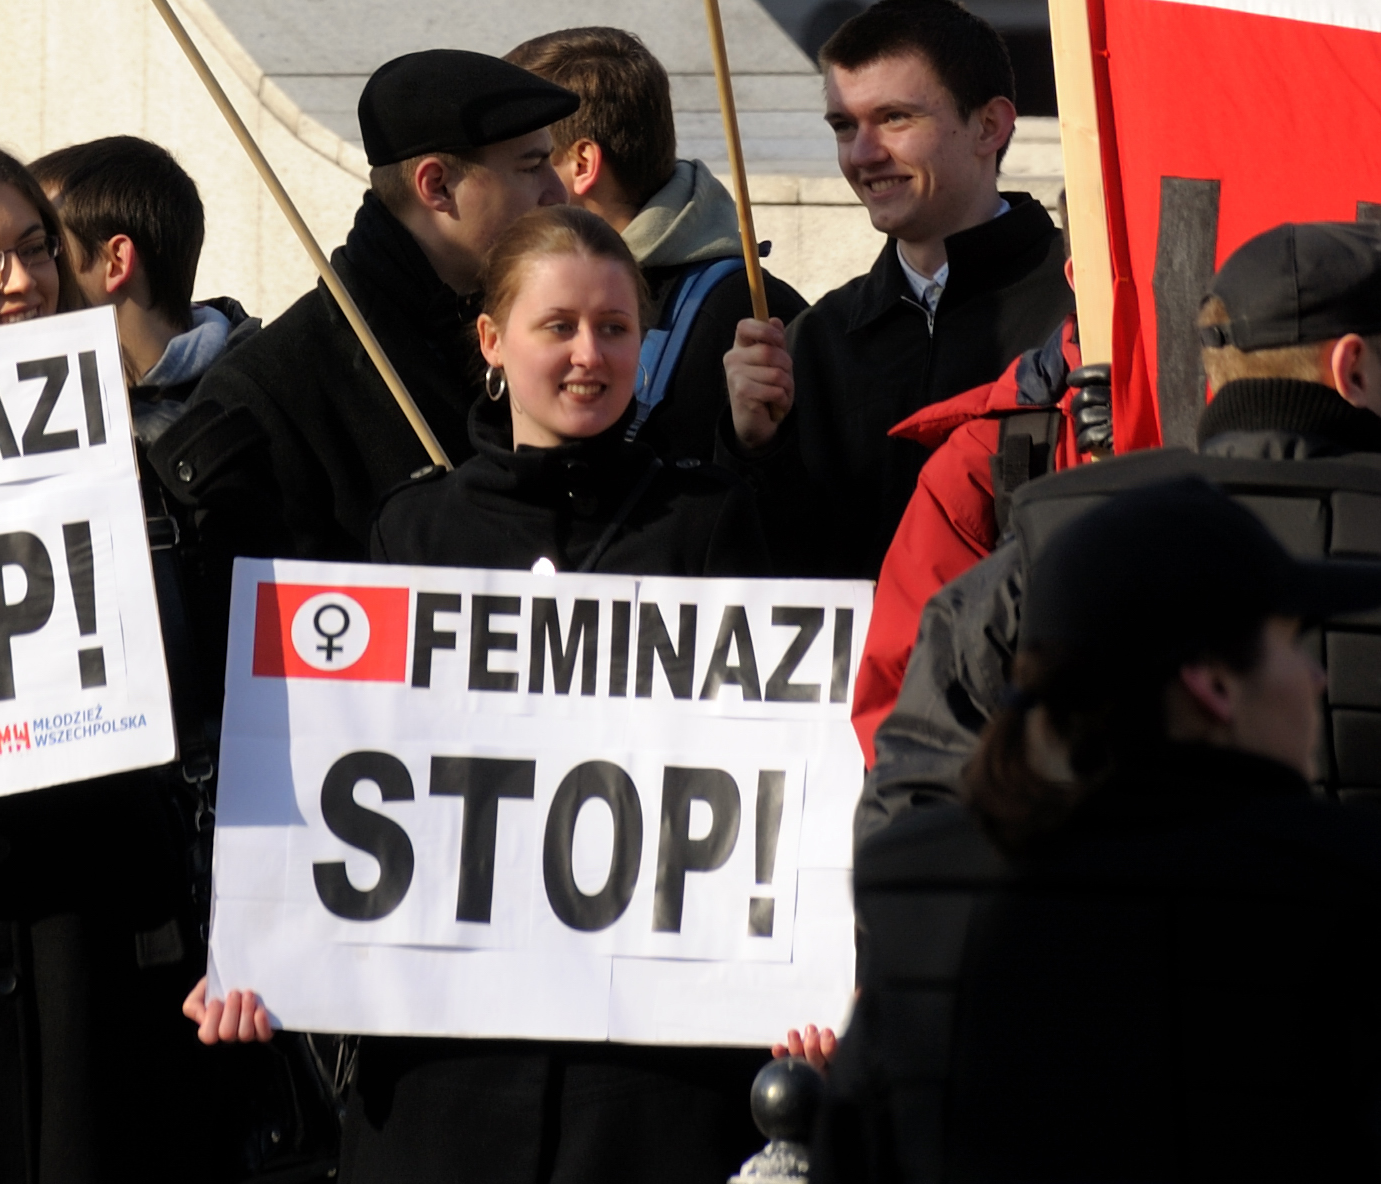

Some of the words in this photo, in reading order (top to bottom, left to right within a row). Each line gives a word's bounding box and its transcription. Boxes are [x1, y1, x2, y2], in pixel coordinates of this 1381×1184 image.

[411, 590, 855, 704] FEMINAZI
[33, 703, 104, 733] MŁODZIEŻ
[34, 713, 148, 749] WSZECHPOLSKA
[312, 749, 787, 938] STOP!
